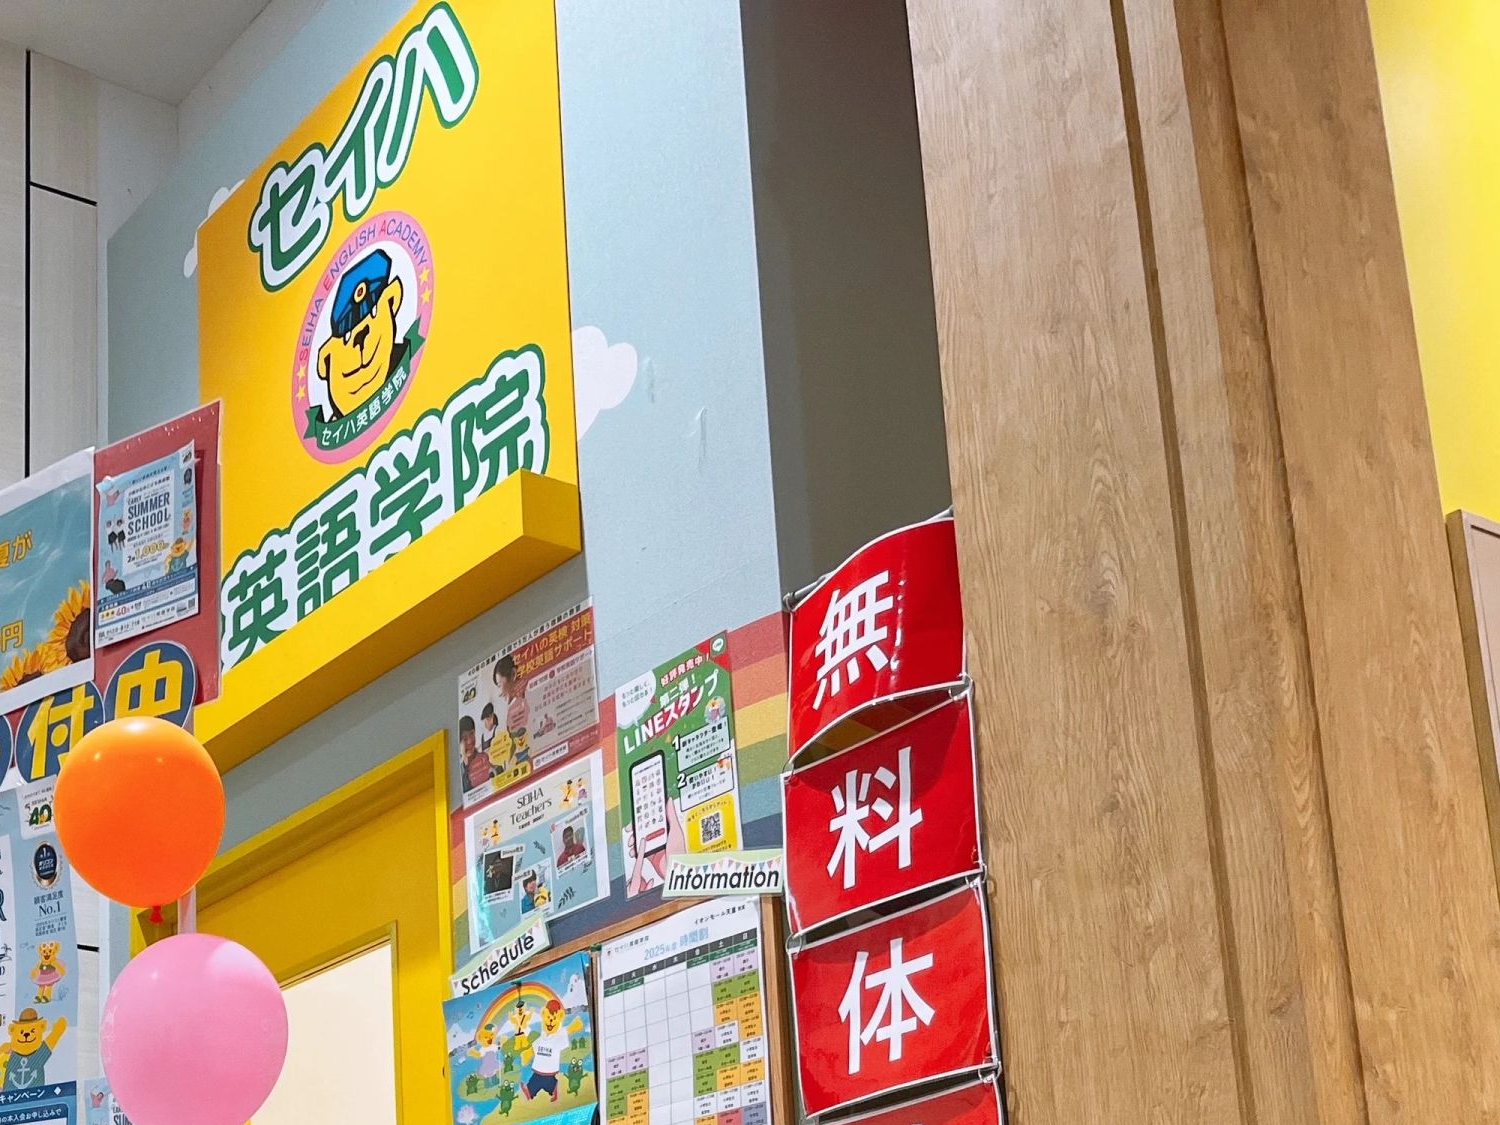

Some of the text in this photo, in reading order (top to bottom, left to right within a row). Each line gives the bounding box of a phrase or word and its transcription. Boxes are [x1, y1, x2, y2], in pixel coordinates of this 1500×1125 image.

[250, 2, 478, 293] セイハ
[300, 219, 427, 361] SEIHA ENGLISH ACADEMY
[322, 366, 407, 446] セイハ英語学院
[128, 492, 170, 520] SUMMER
[127, 507, 170, 535] SCHOOL
[624, 669, 718, 754] LINEスタンプ
[517, 787, 544, 809] SEIHA
[510, 800, 552, 826] Teachers
[669, 866, 779, 891] Information
[38, 902, 61, 917] No.1
[461, 933, 534, 996] Schedule
